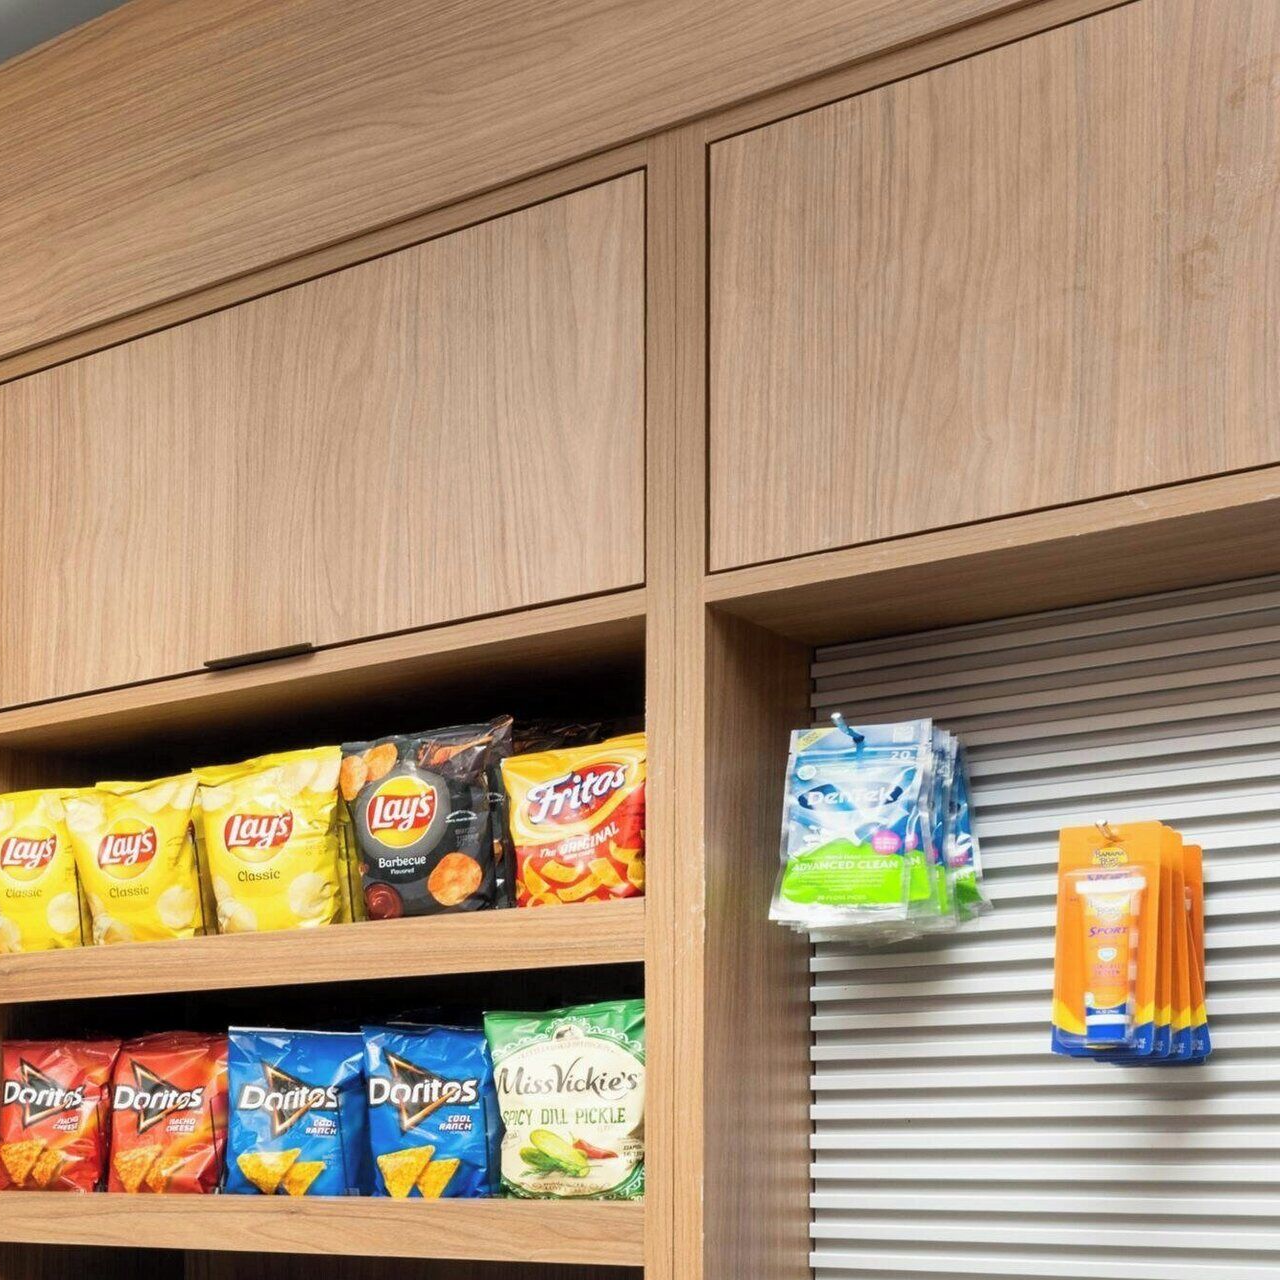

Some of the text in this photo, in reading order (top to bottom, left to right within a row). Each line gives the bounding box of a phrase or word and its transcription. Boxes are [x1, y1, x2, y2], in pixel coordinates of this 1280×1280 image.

[891, 751, 910, 760] 20
[527, 764, 628, 824] Fritos
[371, 792, 434, 831] Lay's
[228, 810, 292, 849] Lay's
[101, 826, 155, 866] Lay's
[540, 822, 620, 858] The ORIGINAL
[3, 837, 54, 868] Lay's
[378, 856, 426, 869] Barbecue
[791, 859, 898, 872] ADVANCED CLEAN
[237, 868, 281, 882] Classic
[5, 886, 42, 898] Classic
[109, 885, 150, 898] Classic
[1089, 927, 1127, 938] SPORT
[498, 1056, 638, 1100] Miss Vickie's
[3, 1081, 83, 1106] Doritos
[113, 1085, 203, 1110] Doritos
[240, 1084, 339, 1110] Doritos
[369, 1077, 478, 1105] Doritos
[169, 1117, 196, 1125] NACHO
[314, 1118, 337, 1127] COOL
[447, 1115, 472, 1123] COOL
[503, 1107, 626, 1127] SPICY DILL PICKLE
[166, 1125, 195, 1133] CHEESE
[305, 1126, 337, 1135] RANCH
[439, 1122, 472, 1131] RANCH
